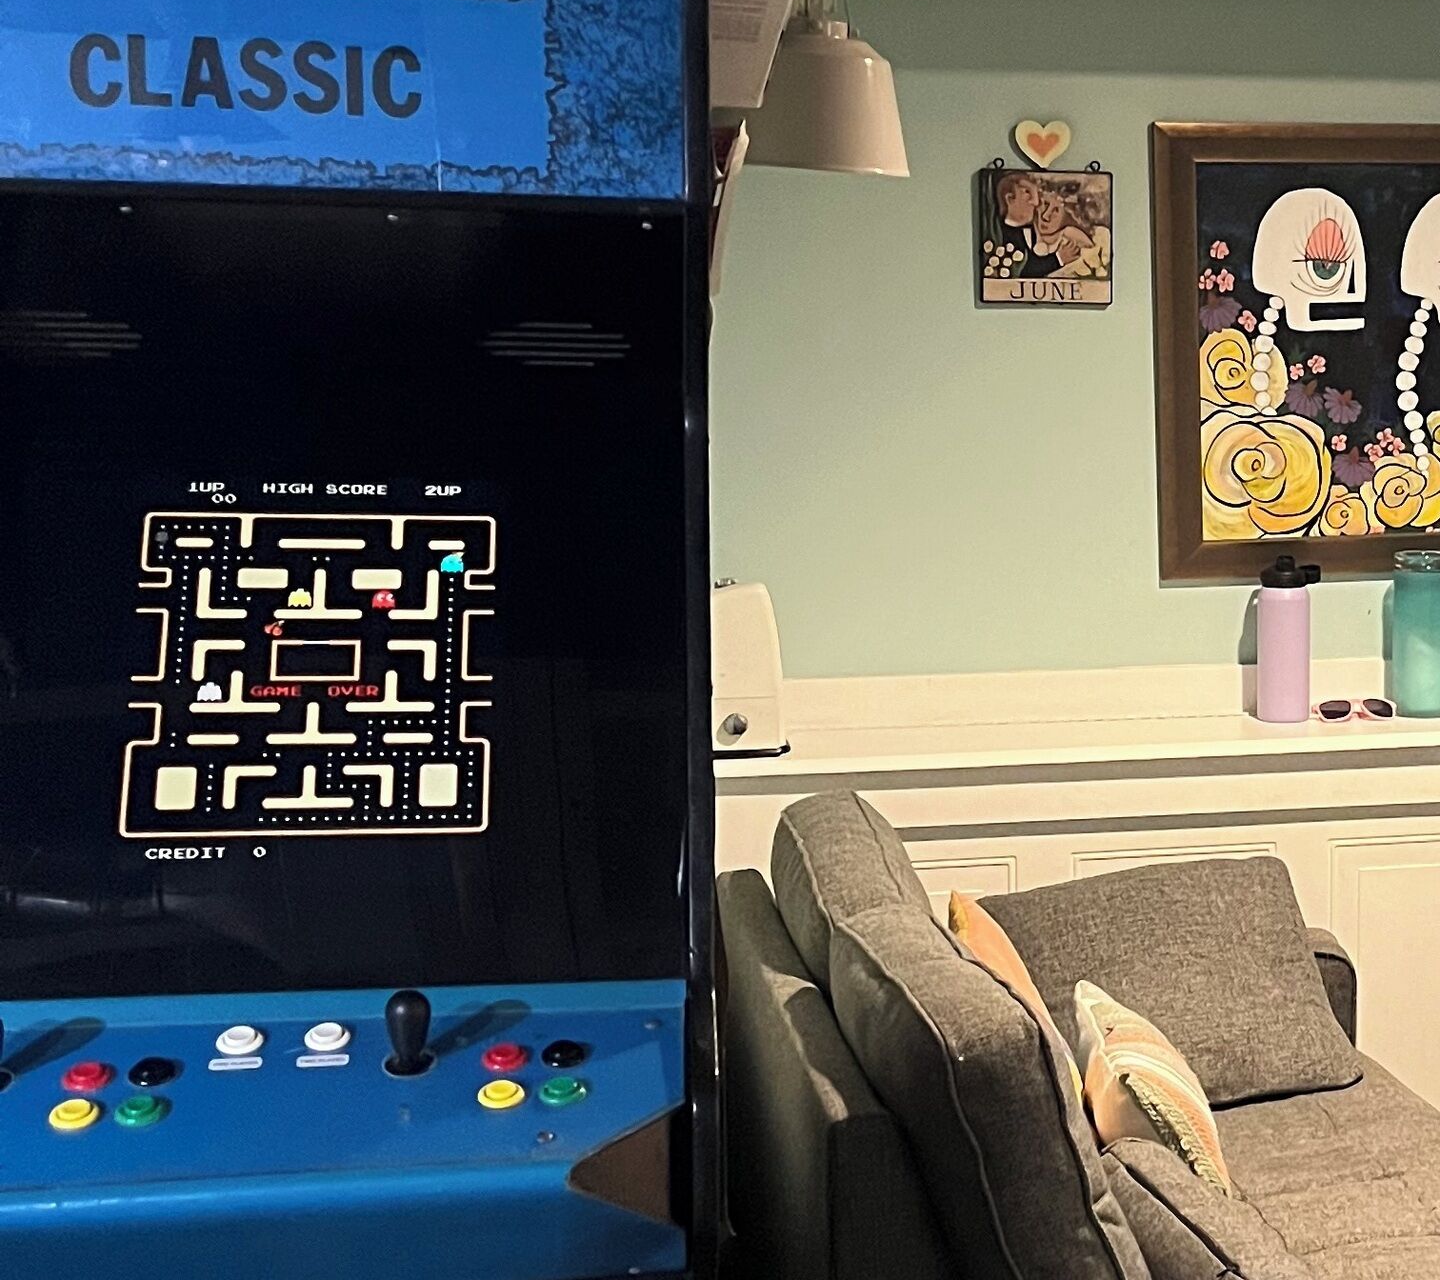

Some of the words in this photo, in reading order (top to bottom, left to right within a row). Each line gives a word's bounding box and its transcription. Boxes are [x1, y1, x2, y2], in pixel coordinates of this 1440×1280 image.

[69, 32, 422, 119] CLASSIC
[1010, 281, 1083, 300] JUNE
[188, 482, 225, 493] 1UP
[262, 483, 314, 495] HIGH
[325, 483, 388, 495] SCORE
[424, 484, 462, 496] 2UP
[211, 493, 237, 504] 00
[249, 684, 302, 696] GAME
[327, 684, 379, 696] OVER
[144, 847, 226, 860] CREDIT
[252, 846, 267, 859] 0
